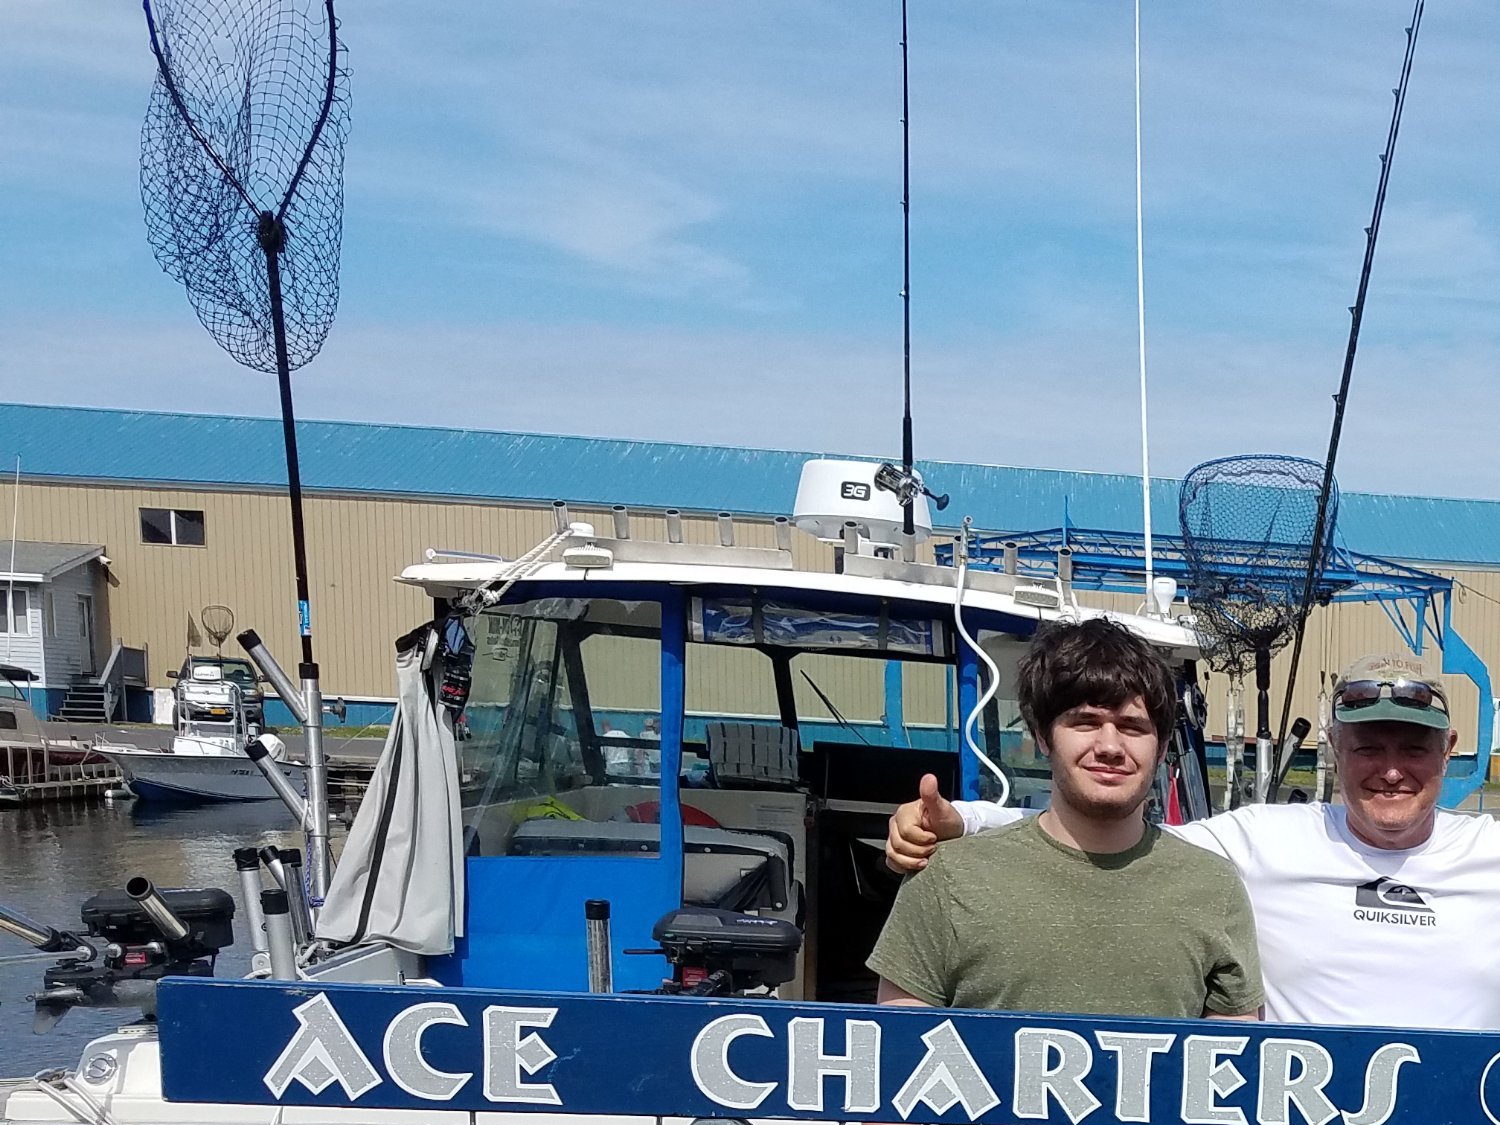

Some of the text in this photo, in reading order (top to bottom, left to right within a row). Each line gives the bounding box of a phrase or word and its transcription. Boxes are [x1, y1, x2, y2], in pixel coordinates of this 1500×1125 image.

[843, 484, 867, 498] 3G
[1353, 909, 1437, 927] QUIKSILVER
[263, 992, 563, 1105] ACE
